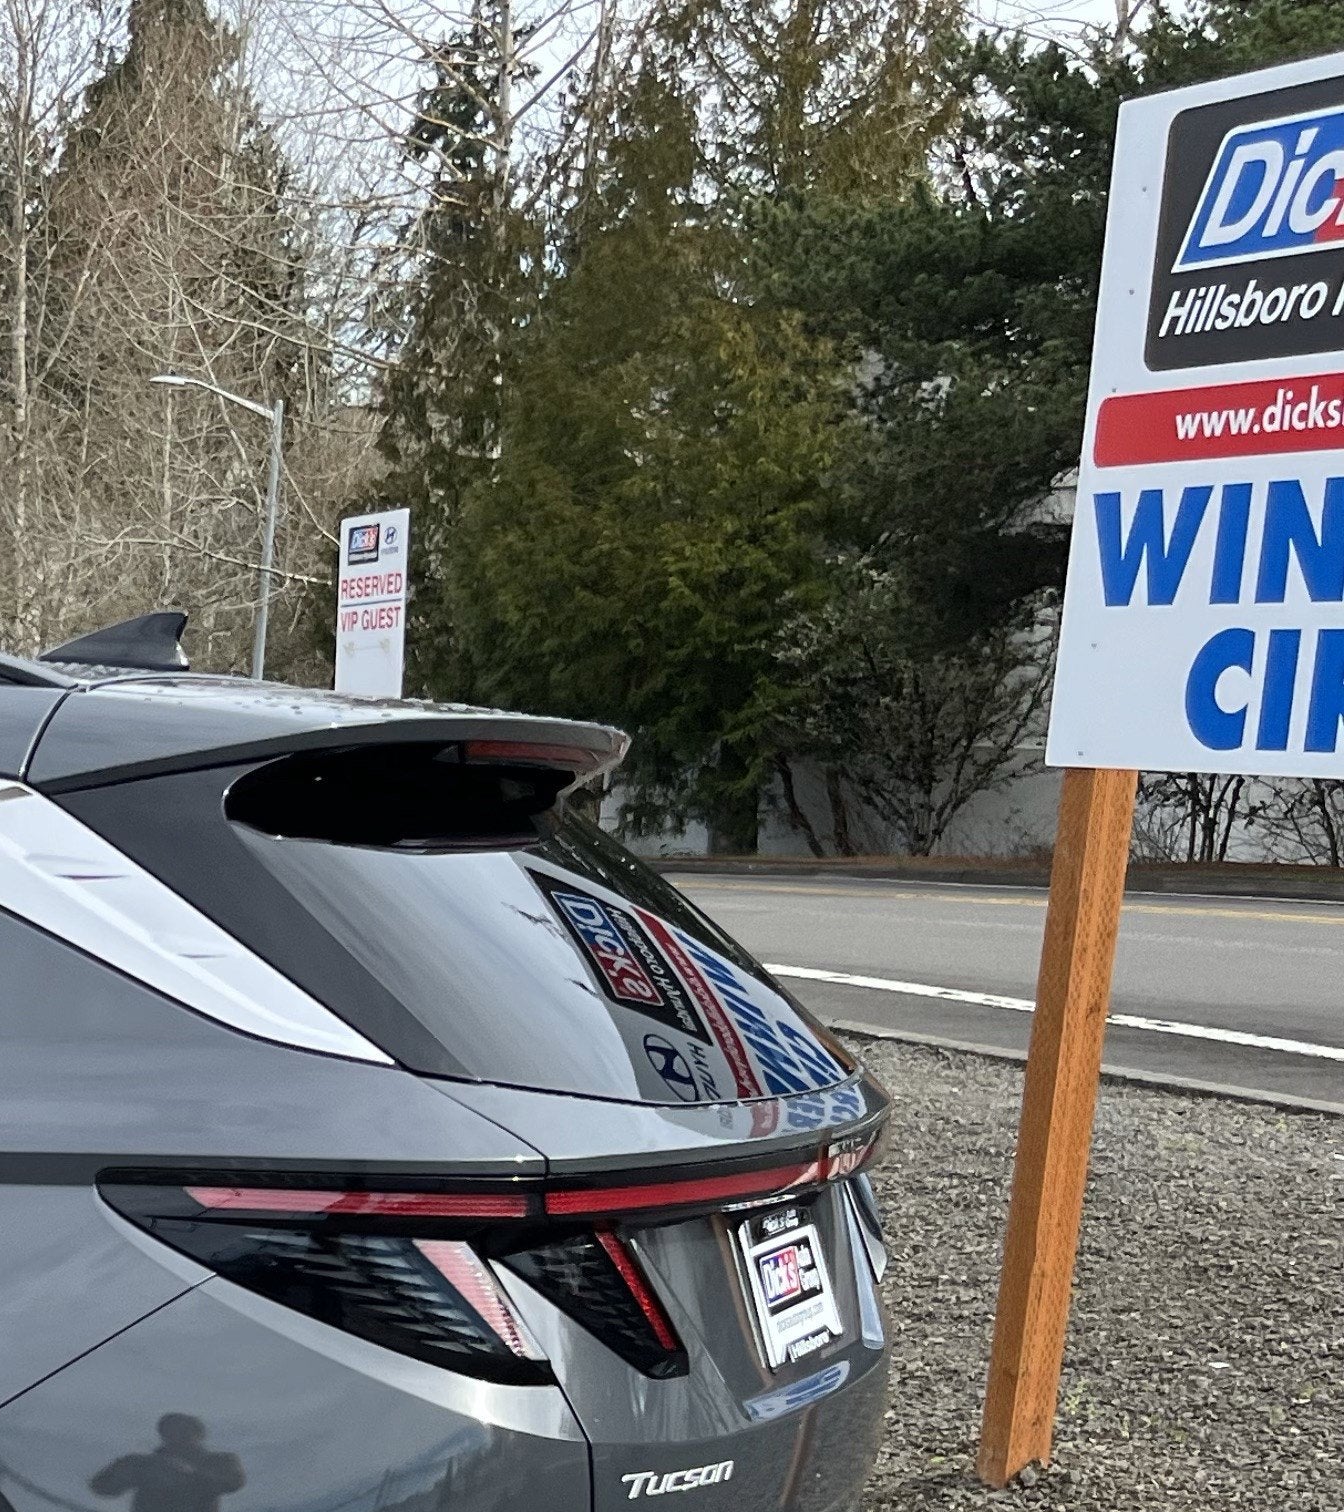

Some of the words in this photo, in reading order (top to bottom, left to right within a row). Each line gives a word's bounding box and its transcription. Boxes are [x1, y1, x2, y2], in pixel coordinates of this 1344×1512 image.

[1198, 127, 1344, 248] Dic
[1158, 279, 1328, 337] Hillsboro
[1175, 385, 1344, 440] www.dicks
[341, 573, 402, 600] RESERVED
[341, 611, 358, 632] VIP
[361, 606, 401, 630] GUEST
[621, 1461, 734, 1499] Tucson
